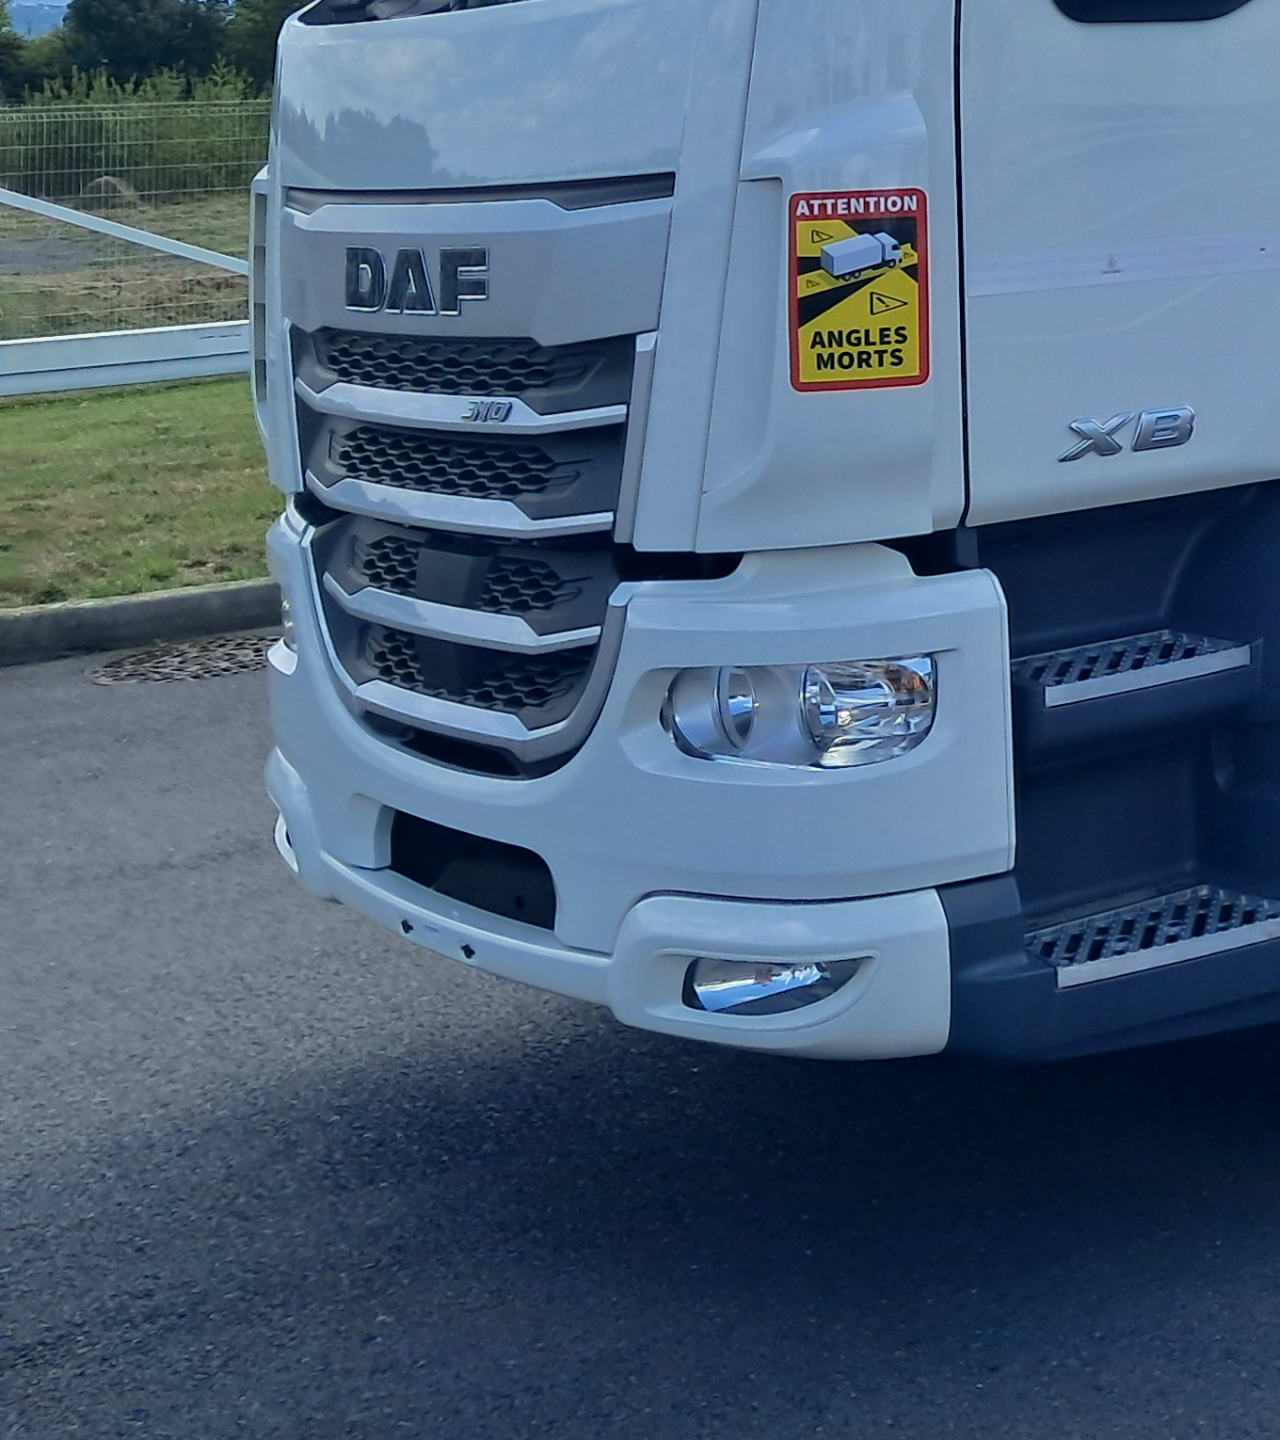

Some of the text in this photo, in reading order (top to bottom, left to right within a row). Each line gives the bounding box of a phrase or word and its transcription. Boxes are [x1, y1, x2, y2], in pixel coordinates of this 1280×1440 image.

[795, 194, 918, 216] ATTENTION
[344, 244, 490, 316] DAF
[810, 326, 908, 349] ANGLES
[816, 348, 904, 371] MORTS
[1056, 404, 1196, 463] XB
